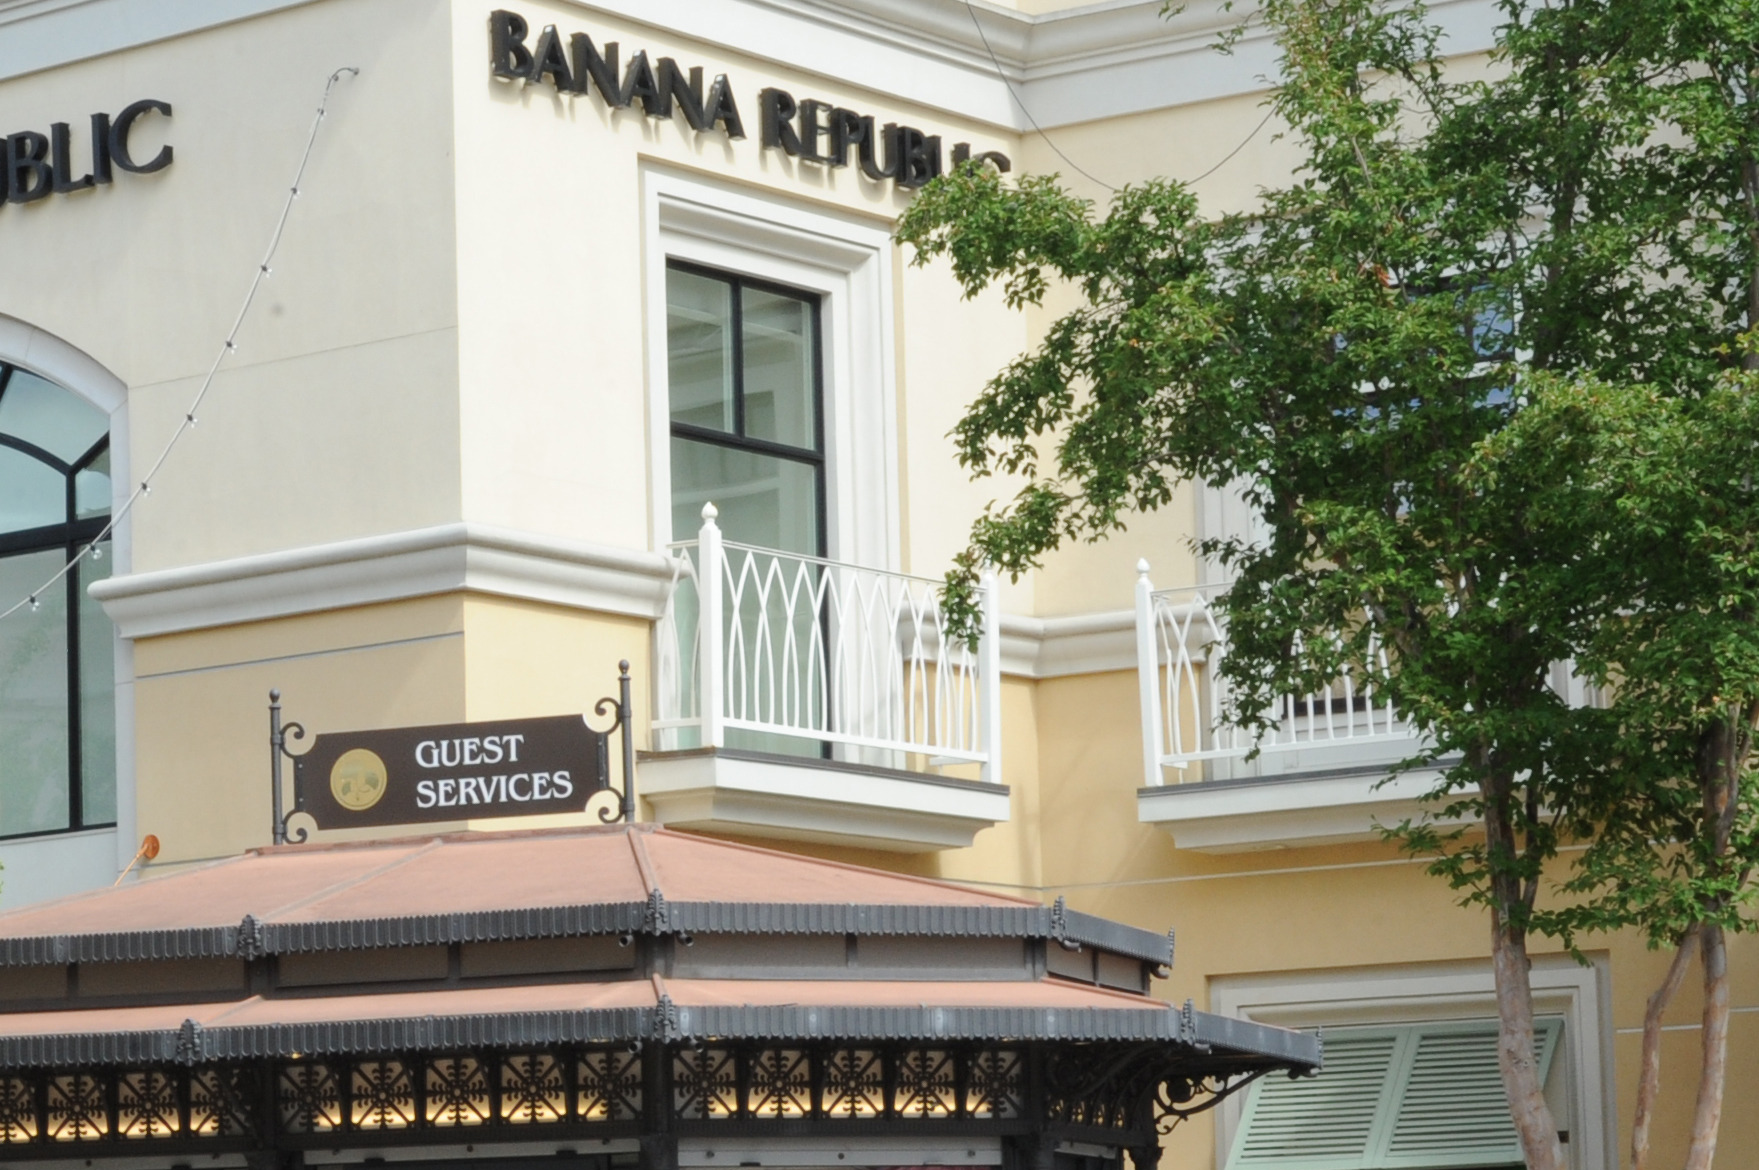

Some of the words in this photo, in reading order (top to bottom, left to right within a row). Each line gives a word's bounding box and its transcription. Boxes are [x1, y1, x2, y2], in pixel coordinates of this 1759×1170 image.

[490, 9, 746, 140] BANANA
[414, 734, 525, 768] GUEST
[416, 770, 574, 809] SERVICES
